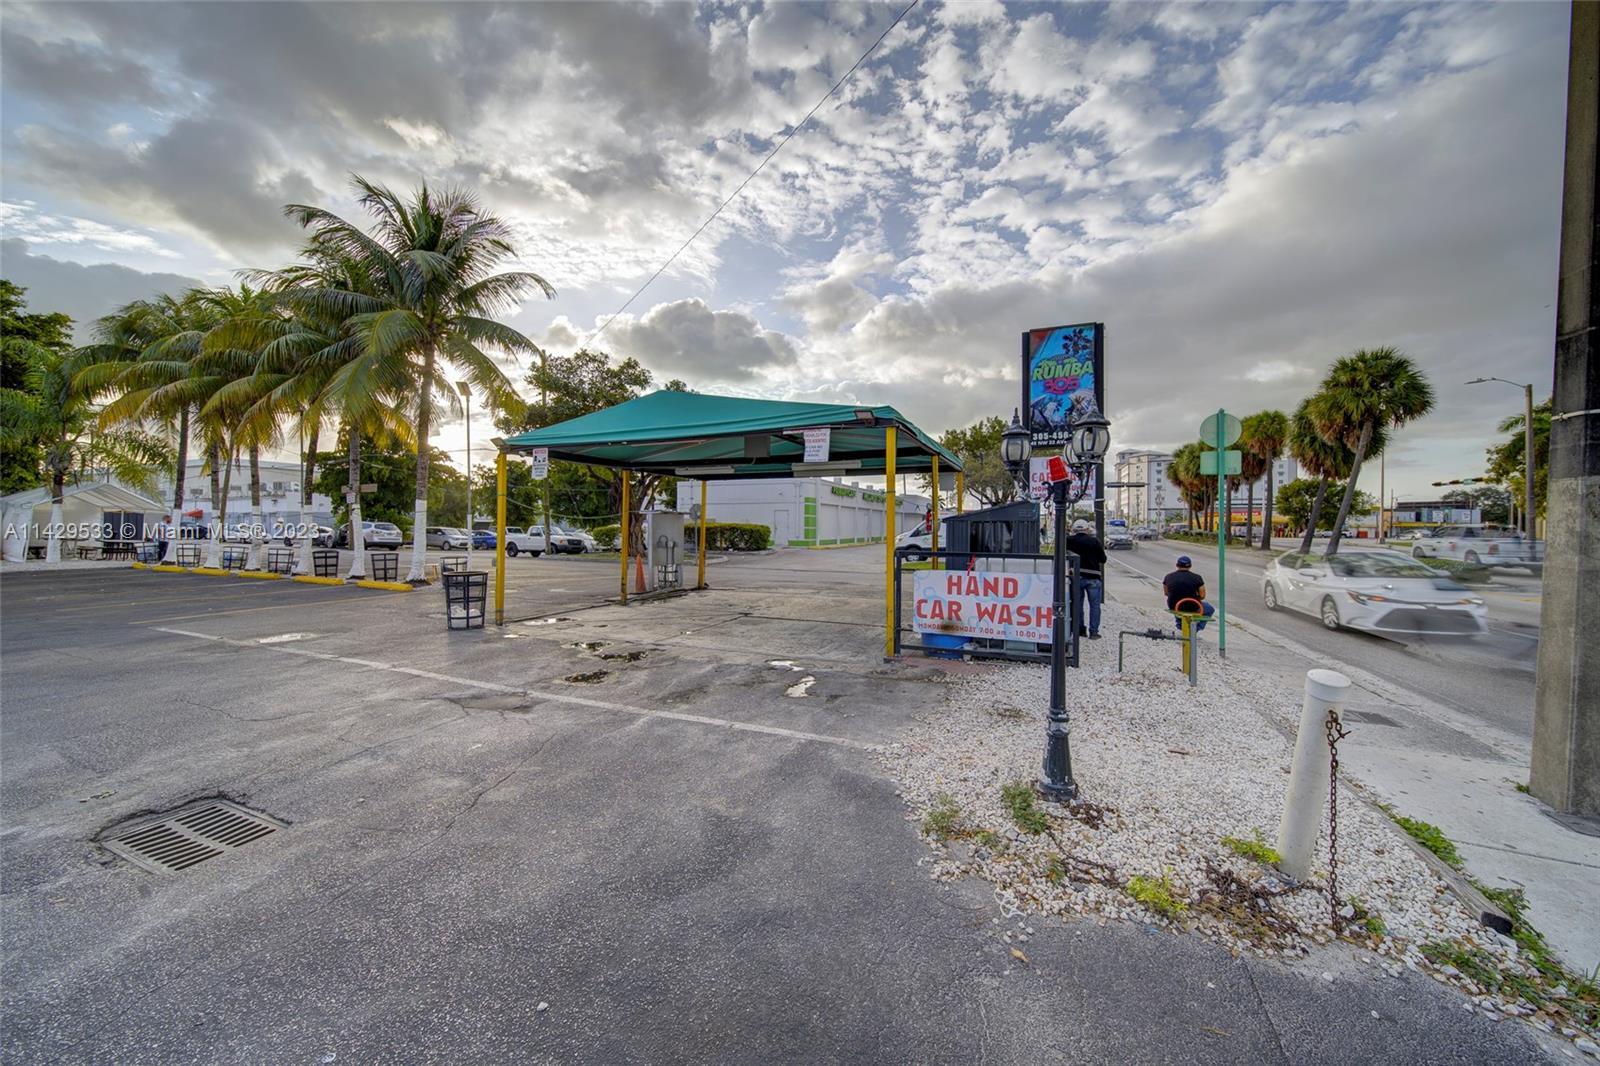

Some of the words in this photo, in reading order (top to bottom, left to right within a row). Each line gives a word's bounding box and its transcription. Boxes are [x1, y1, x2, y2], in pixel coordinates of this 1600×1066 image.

[1032, 360, 1094, 381] RUMBA
[947, 575, 1019, 598] HAND
[915, 599, 962, 621] CAR
[975, 602, 1053, 629] WASH
